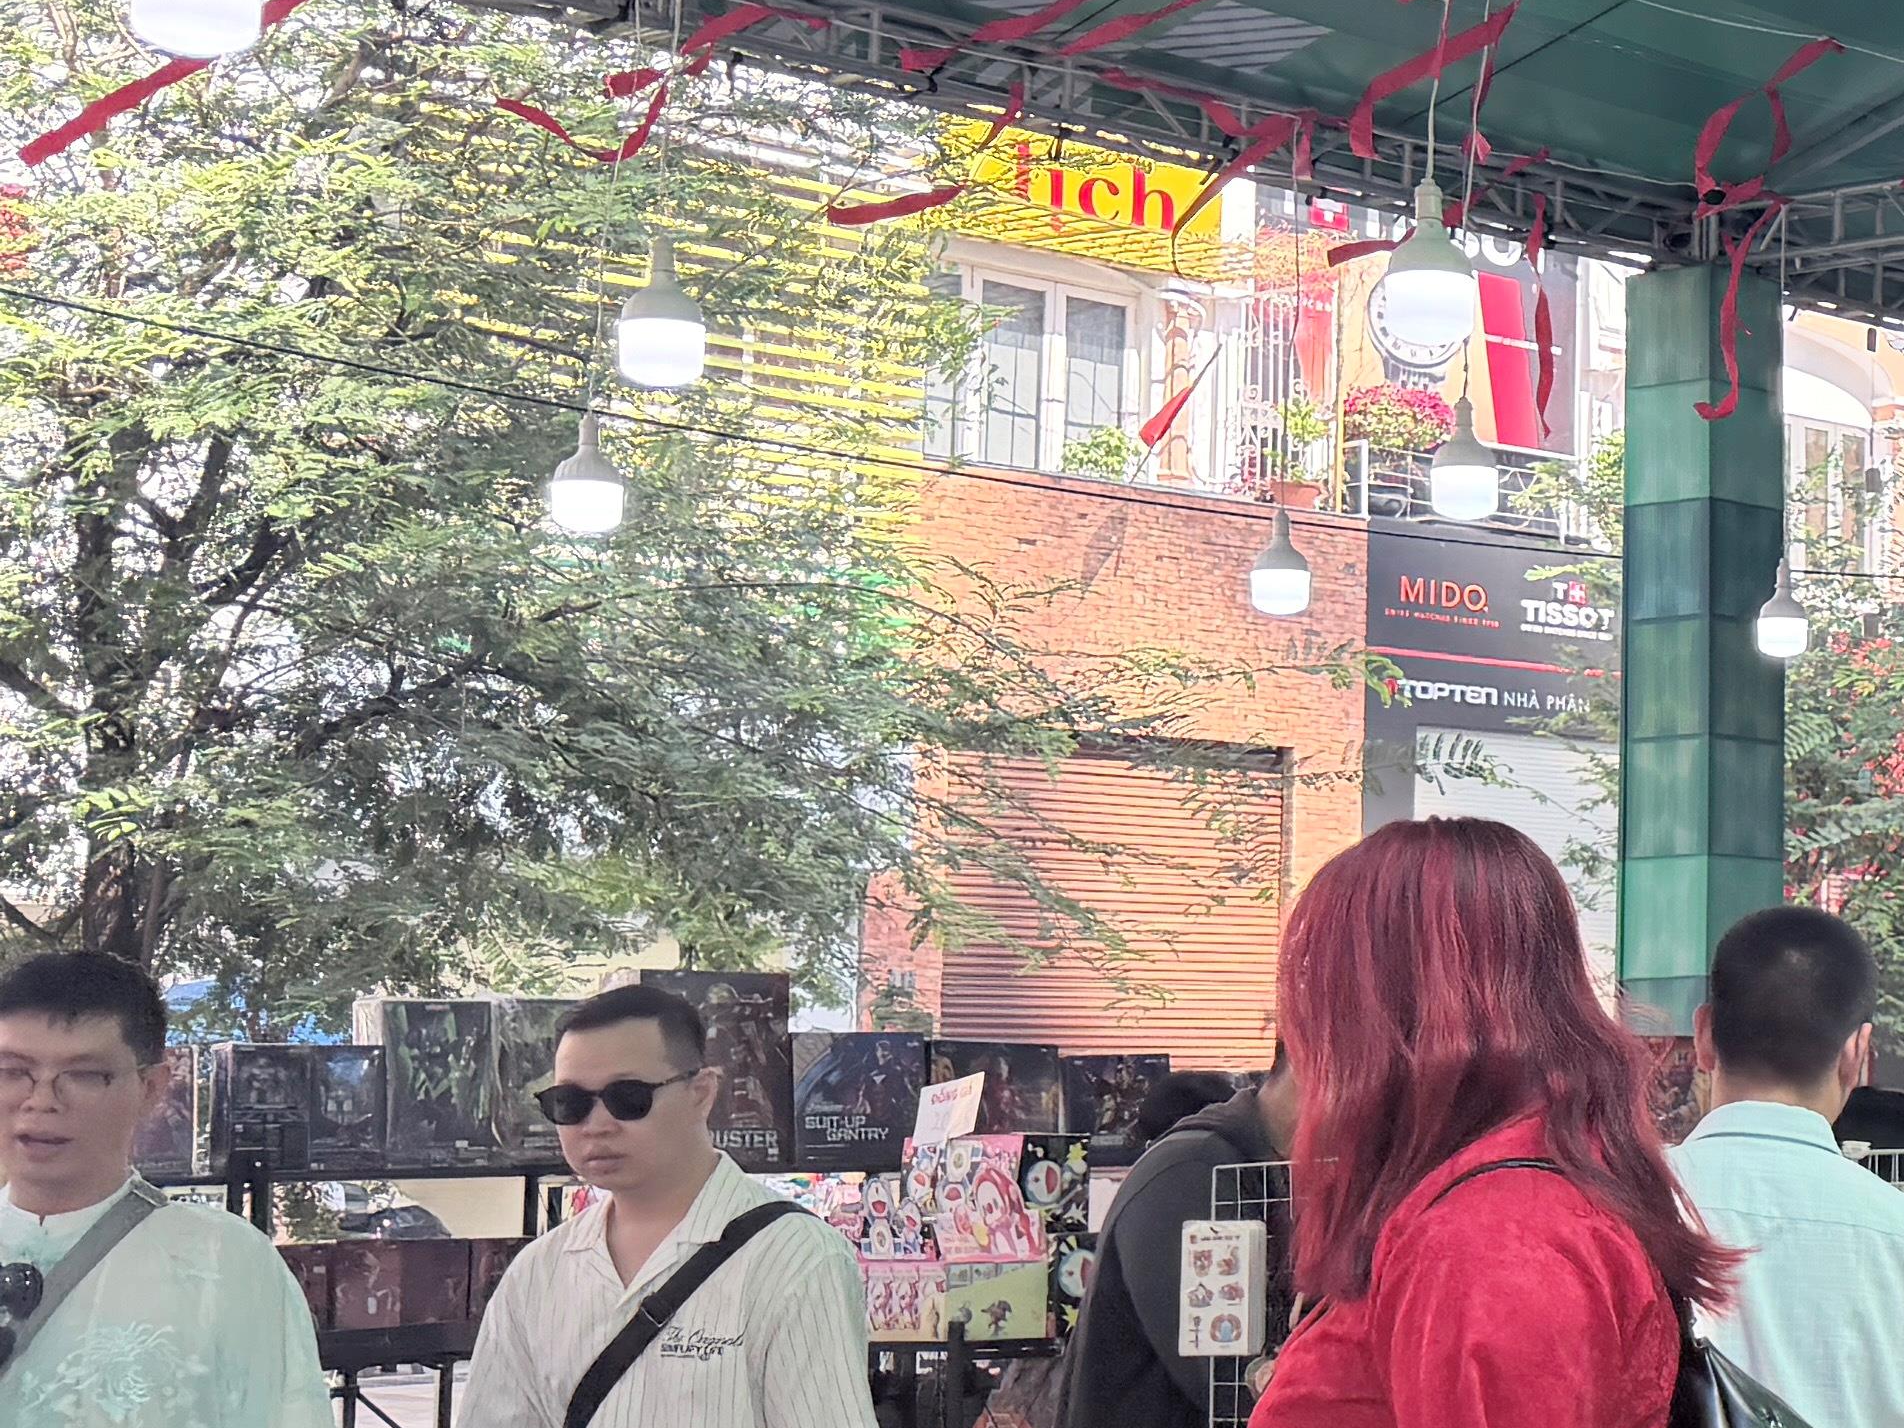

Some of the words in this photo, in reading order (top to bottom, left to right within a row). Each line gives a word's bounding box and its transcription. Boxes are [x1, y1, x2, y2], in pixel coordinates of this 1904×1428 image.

[1400, 575, 1488, 613] MIDO
[1520, 599, 1616, 630] TISSOT
[1504, 689, 1540, 710] NHÀ
[804, 1115, 867, 1130] SUIT-UP
[825, 1127, 889, 1142] GANTRY
